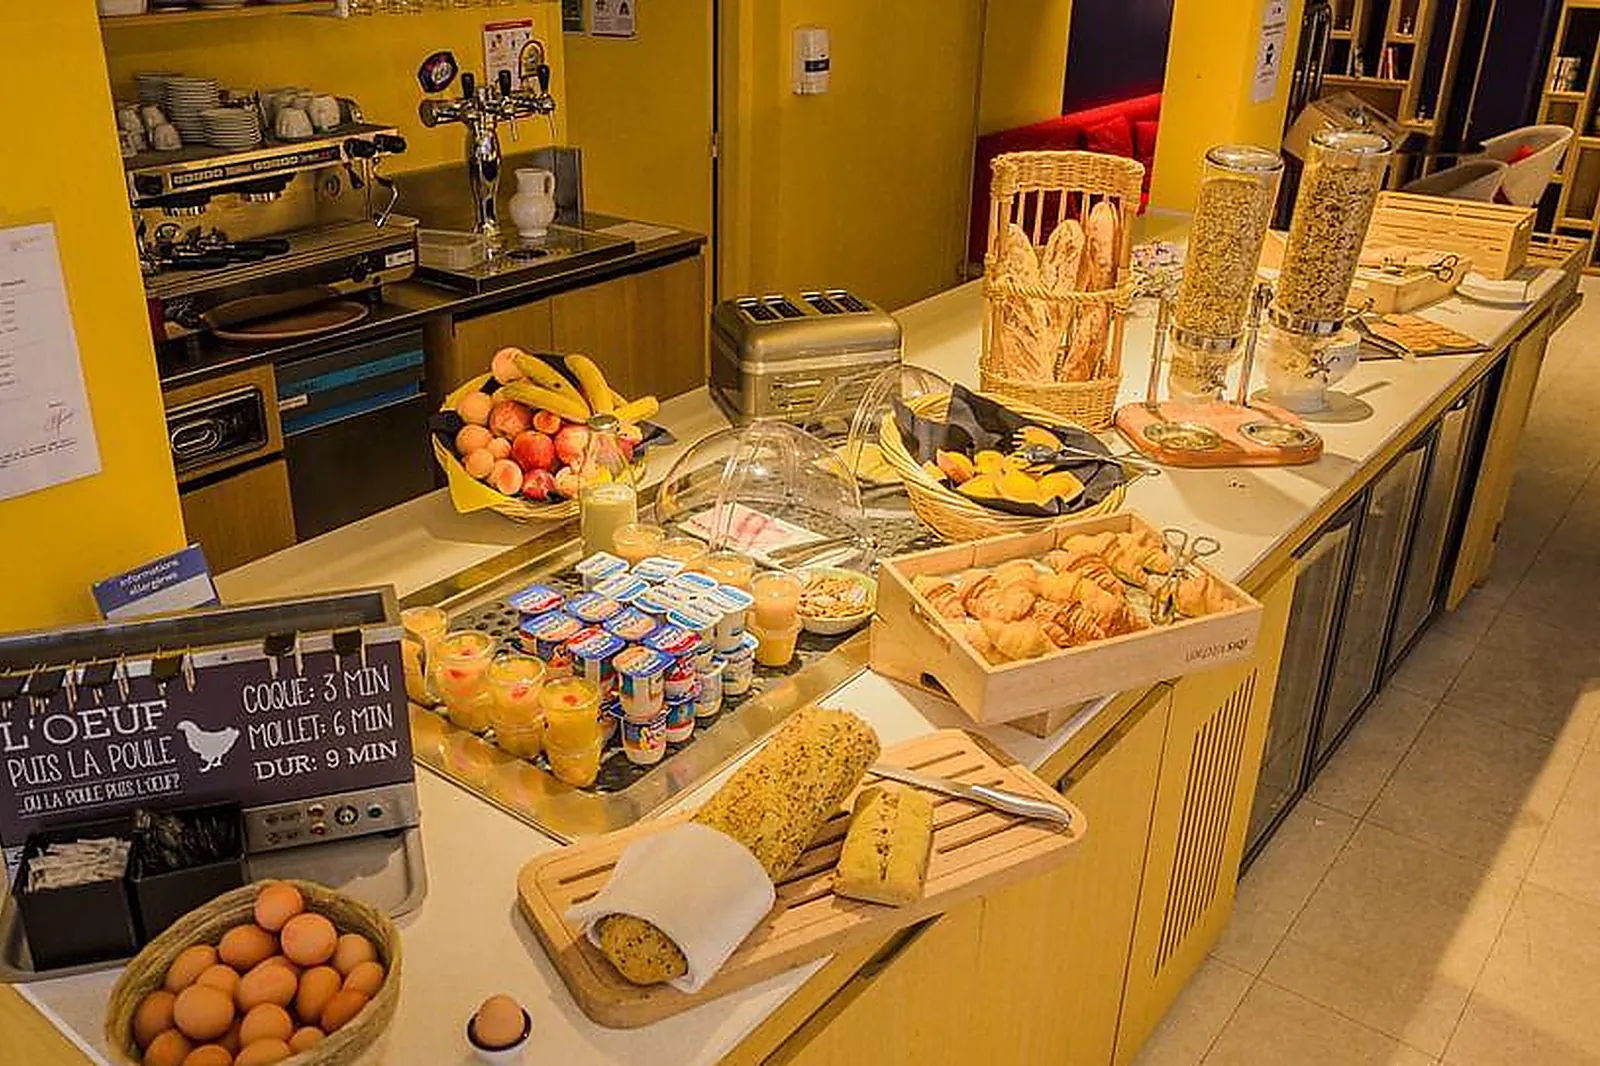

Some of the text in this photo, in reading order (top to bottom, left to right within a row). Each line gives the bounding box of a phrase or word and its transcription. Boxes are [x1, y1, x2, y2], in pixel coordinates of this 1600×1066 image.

[242, 664, 391, 714] COQUE: 3 MIN
[0, 699, 168, 752] L'OEUF
[247, 702, 394, 751] MOLLET: 6 MIN
[7, 736, 177, 789] PUIS LA POULE
[253, 739, 400, 781] DUR: 9 MIN
[44, 791, 63, 810] LA
[65, 783, 104, 806] POULE
[106, 779, 135, 800] PUIS
